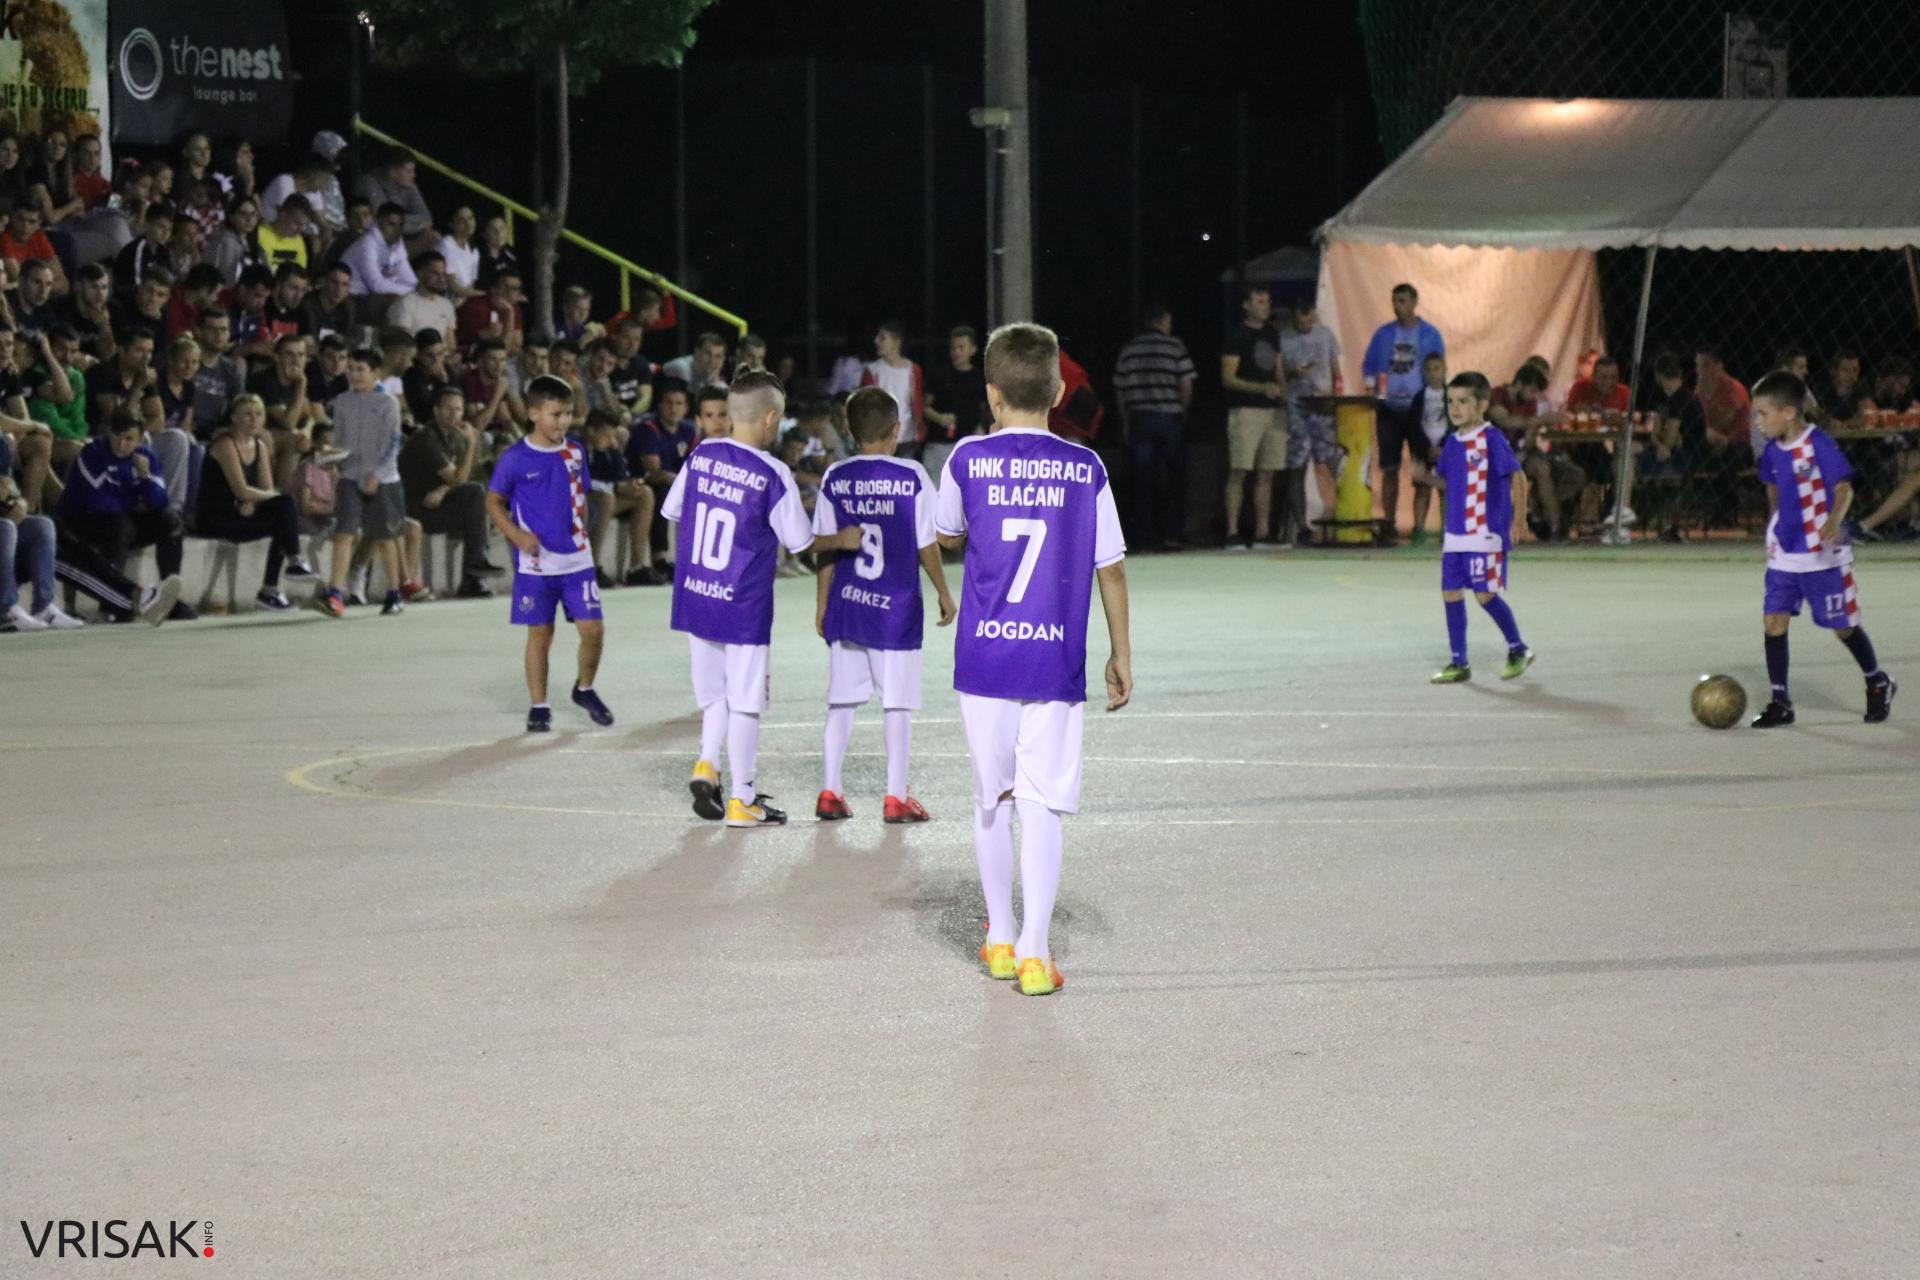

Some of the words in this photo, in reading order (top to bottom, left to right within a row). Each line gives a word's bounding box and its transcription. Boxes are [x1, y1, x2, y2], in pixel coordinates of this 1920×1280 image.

[193, 86, 235, 104] lounge
[239, 88, 257, 102] bar
[690, 455, 713, 471] HNK
[713, 460, 769, 491] BIOGRACI
[968, 458, 1004, 479] HNK
[1010, 458, 1093, 484] BIOGRACI
[831, 479, 851, 496] HNK
[855, 480, 914, 496] BIOGRACI
[987, 483, 1065, 507] BLAĆANI
[691, 502, 736, 571] 10
[854, 522, 885, 580] 9
[1001, 518, 1047, 604] 7
[1470, 557, 1485, 576] 12
[1825, 593, 1845, 613] 17
[976, 619, 1065, 642] BOGDAN
